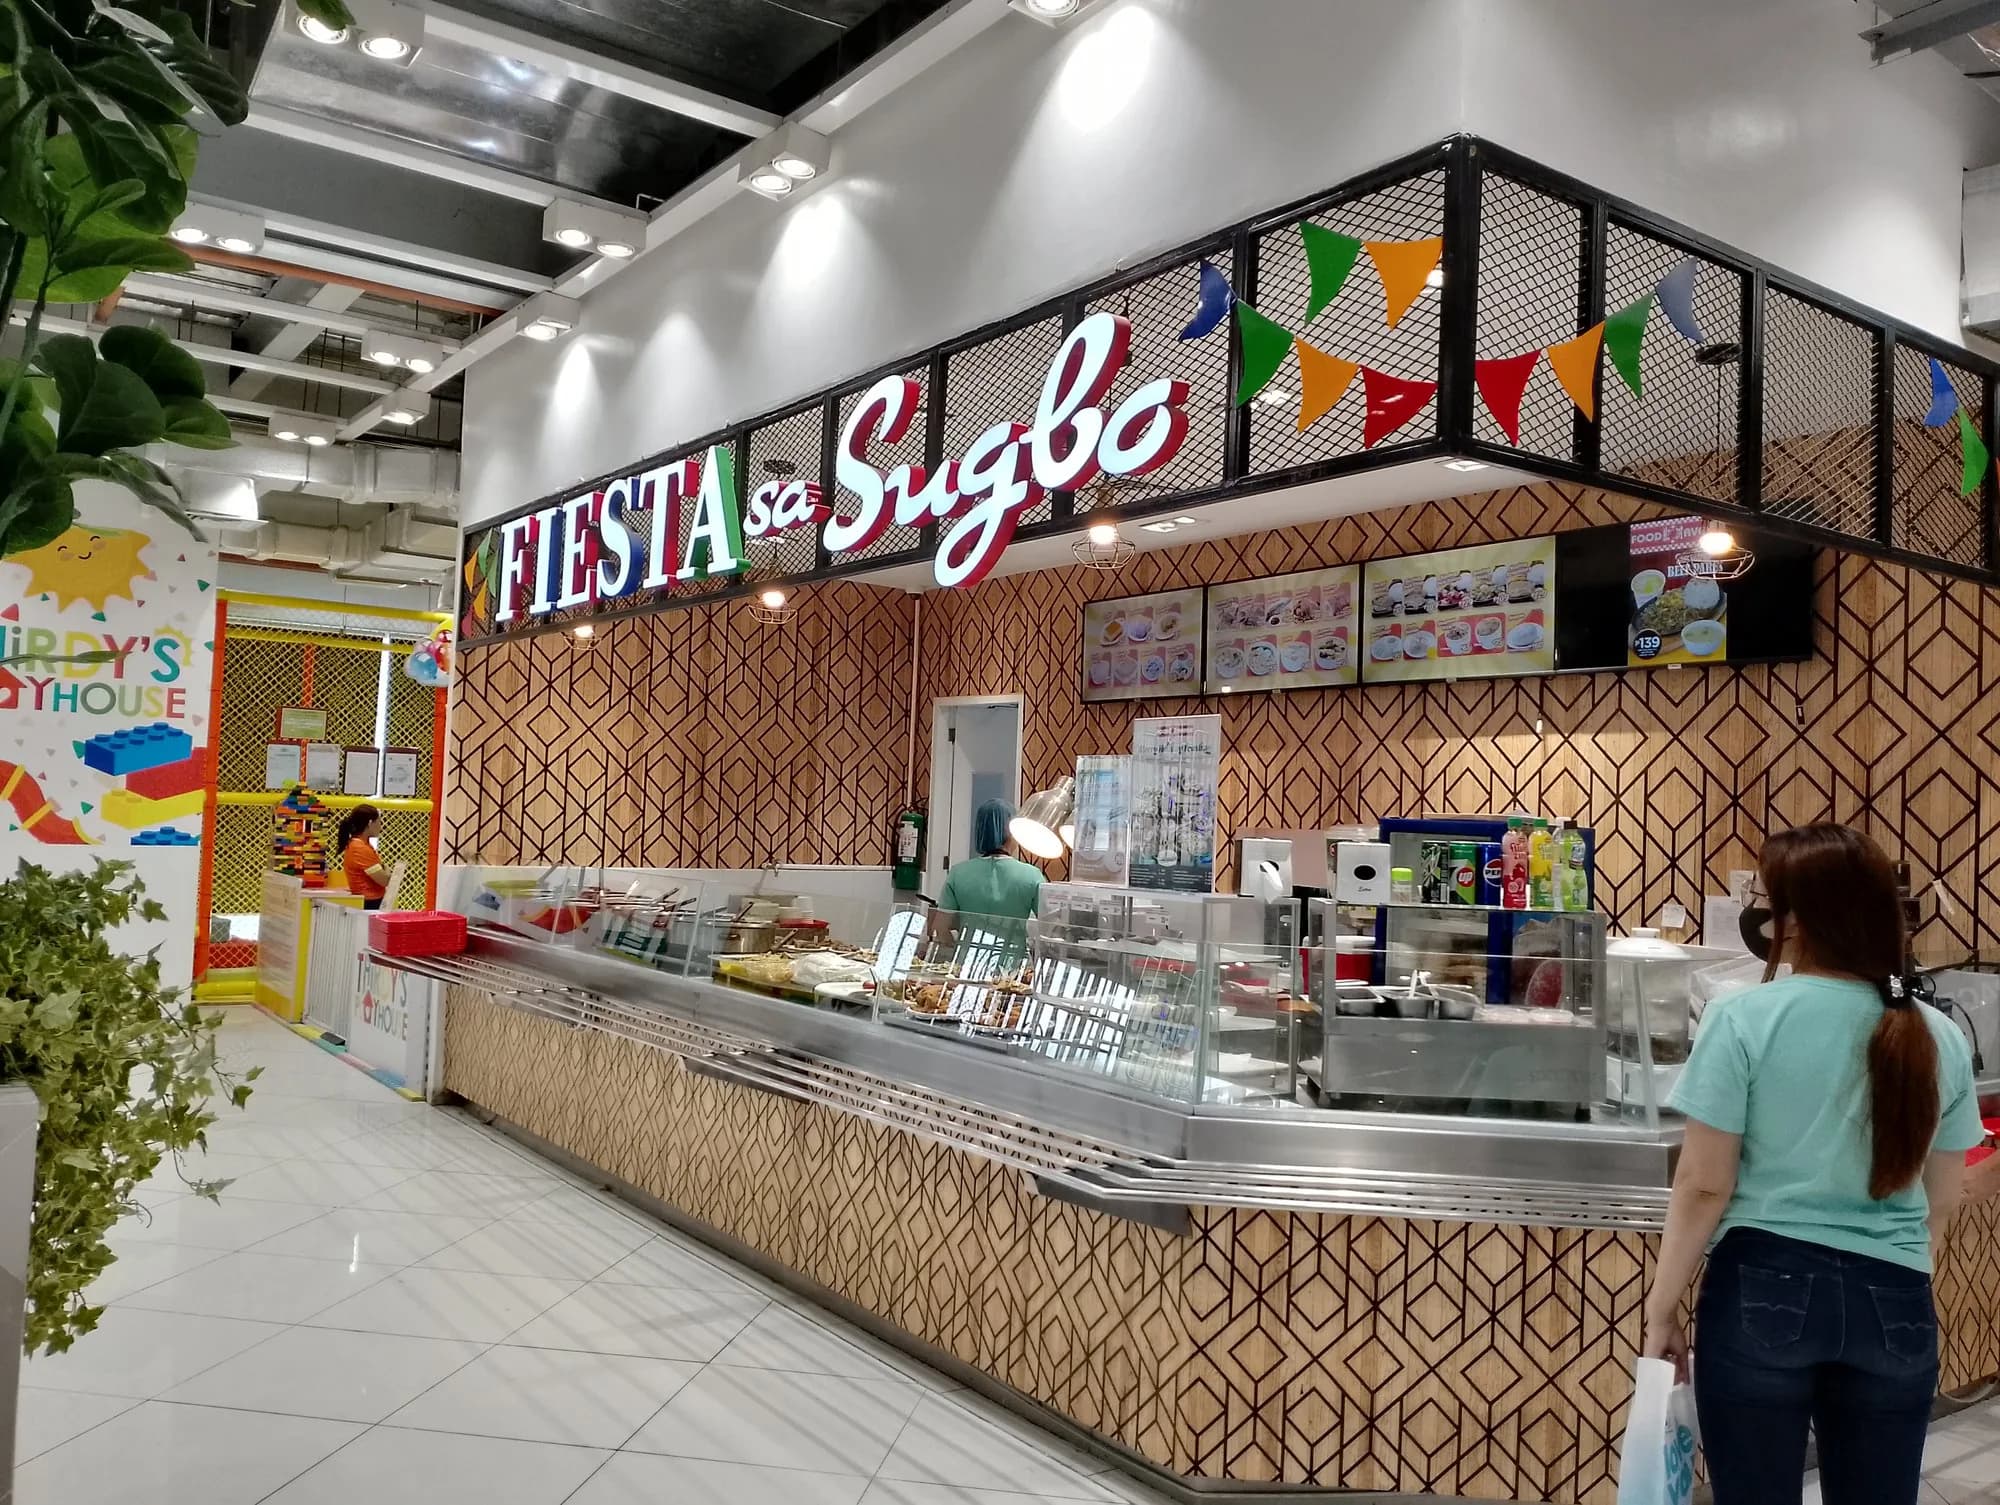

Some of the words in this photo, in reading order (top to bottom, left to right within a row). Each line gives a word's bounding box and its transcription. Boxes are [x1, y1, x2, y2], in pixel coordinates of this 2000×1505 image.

[495, 446, 752, 623] FIESTA
[742, 479, 832, 539] sa
[822, 312, 1190, 588] Sugbo
